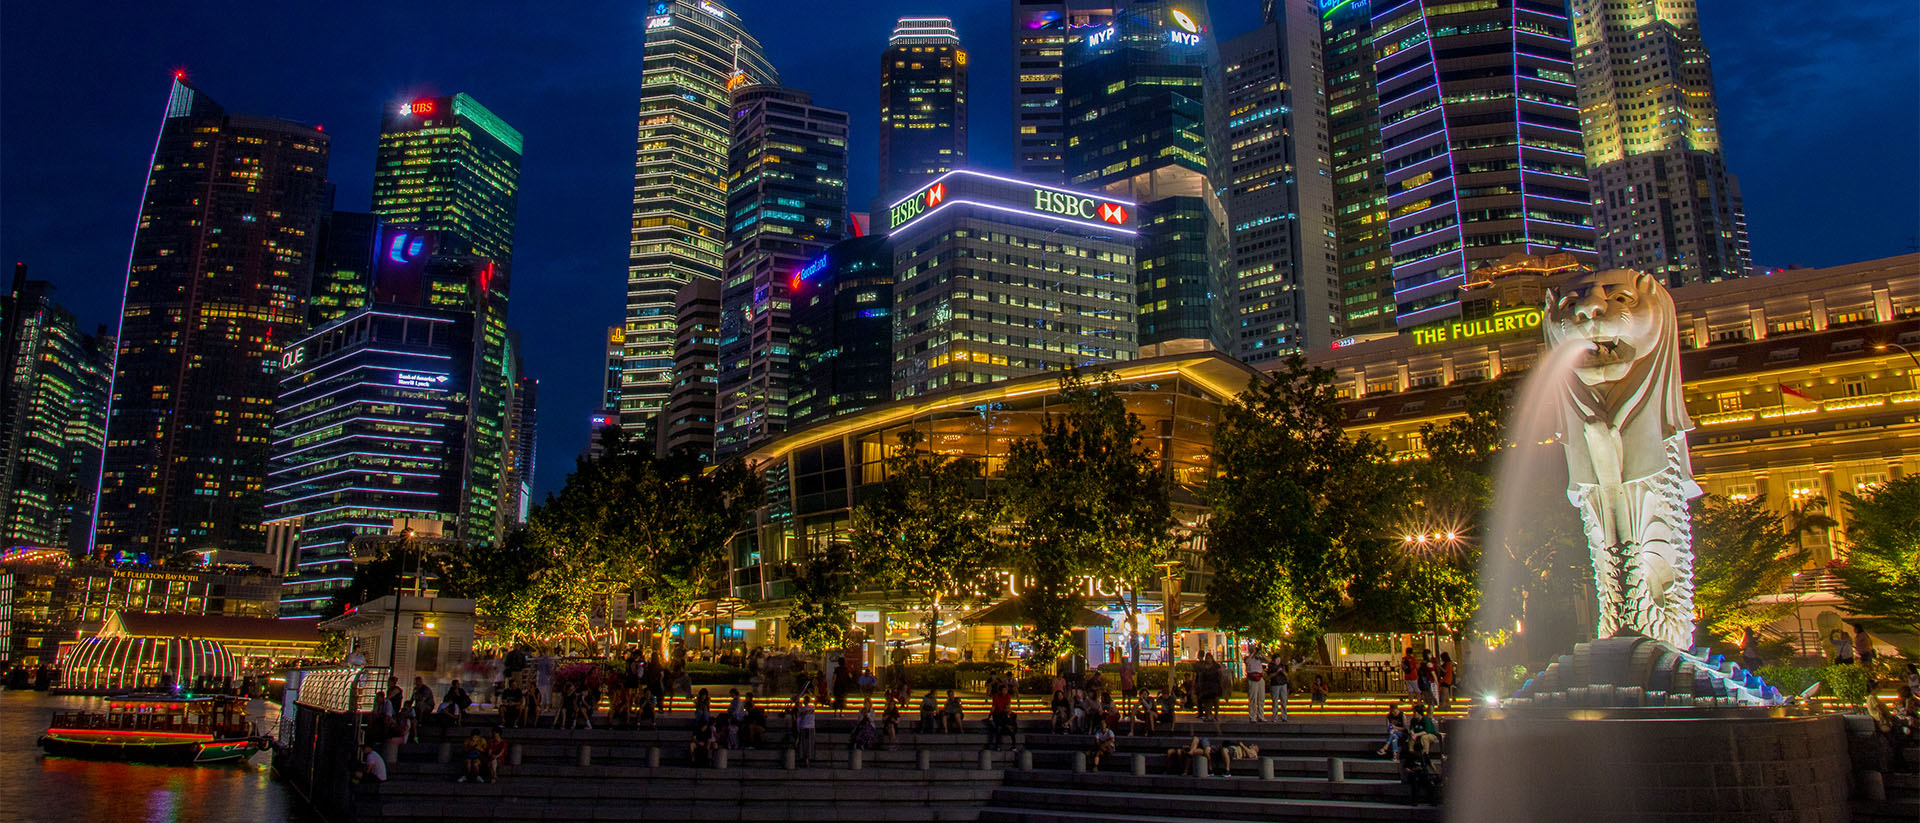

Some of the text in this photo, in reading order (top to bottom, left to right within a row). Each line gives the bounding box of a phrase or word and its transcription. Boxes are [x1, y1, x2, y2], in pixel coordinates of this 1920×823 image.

[647, 16, 671, 28] ANZ
[1089, 27, 1115, 47] MYP
[1170, 30, 1200, 46] MYP
[412, 102, 433, 113] UBS
[890, 191, 927, 229] HSBC
[1033, 188, 1096, 220] HSBC
[1413, 327, 1447, 345] THE
[113, 570, 126, 578] THE
[127, 571, 164, 580] FULLERTON
[178, 574, 199, 582] HOTEL
